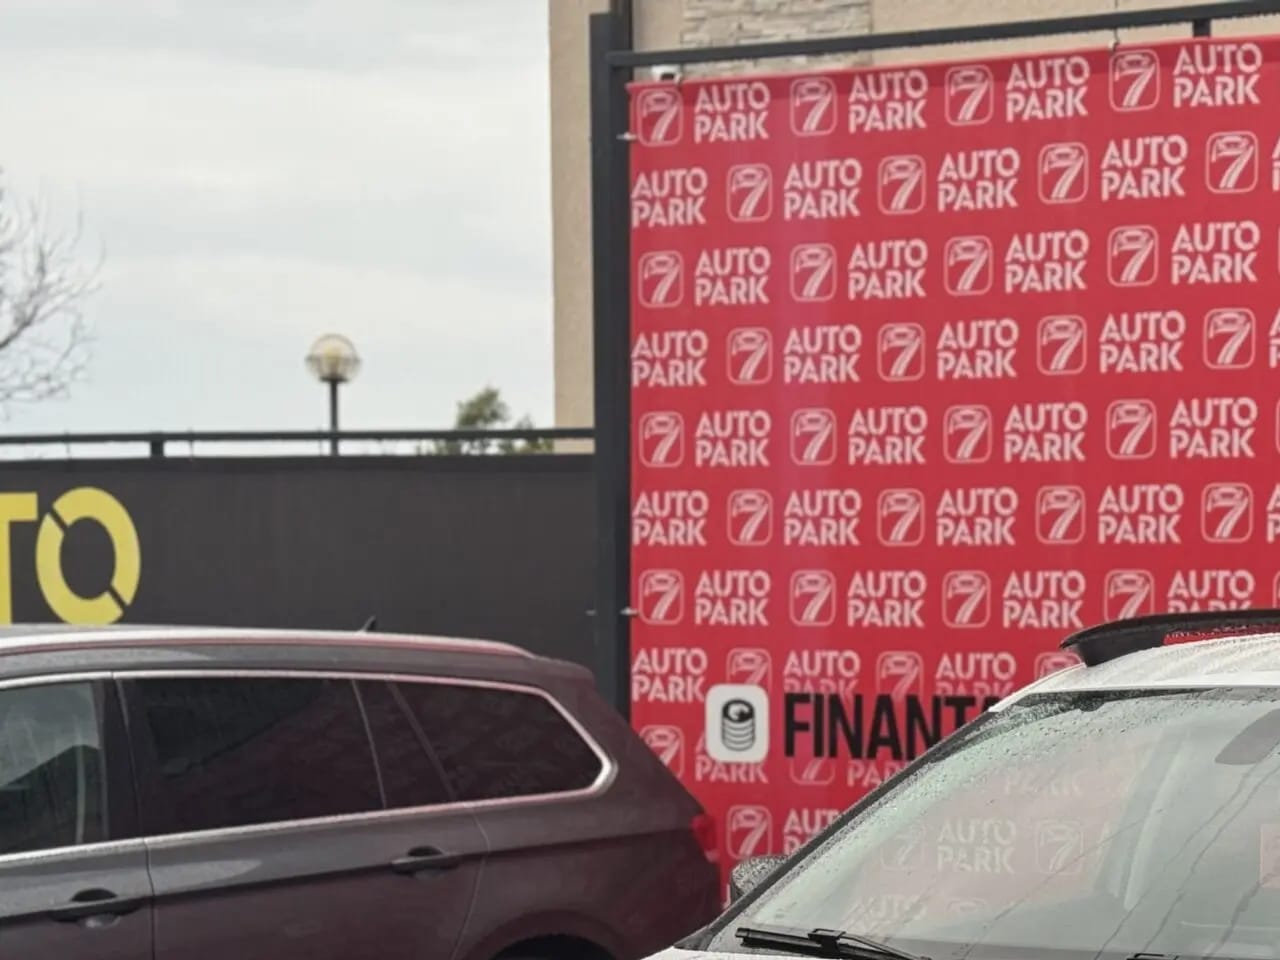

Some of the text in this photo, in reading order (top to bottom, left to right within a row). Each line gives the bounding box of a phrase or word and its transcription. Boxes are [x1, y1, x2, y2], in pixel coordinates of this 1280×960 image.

[1007, 58, 1089, 89] AUTO
[1173, 43, 1262, 77] AUTO
[695, 82, 770, 113] AUTO
[849, 71, 928, 102] AUTO
[1174, 74, 1260, 108] PARK
[849, 99, 926, 132] PARK
[1007, 88, 1088, 121] PARK
[694, 112, 769, 143] PARK
[938, 149, 1019, 179] AUTO
[1102, 135, 1188, 168] AUTO
[631, 169, 708, 200] AUTO
[784, 159, 862, 190] AUTO
[1102, 166, 1185, 201] PARK
[784, 188, 859, 219] PARK
[938, 178, 1018, 211] PARK
[632, 198, 706, 228] PARK
[1005, 230, 1089, 262] AUTO
[1172, 221, 1260, 254] AUTO
[696, 247, 771, 278] AUTO
[849, 239, 928, 271] AUTO
[1172, 251, 1258, 285] PARK
[696, 277, 769, 306] PARK
[849, 269, 926, 300] PARK
[1006, 259, 1086, 293] PARK
[784, 325, 861, 355] AUTO
[938, 319, 1018, 350] AUTO
[1100, 311, 1186, 342] AUTO
[631, 331, 708, 361] AUTO
[1100, 340, 1184, 374] PARK
[632, 358, 706, 388] PARK
[784, 352, 859, 384] PARK
[938, 347, 1017, 380] PARK
[696, 410, 771, 441] AUTO
[849, 408, 928, 439] AUTO
[1005, 402, 1088, 434] AUTO
[1170, 398, 1258, 430] AUTO
[696, 438, 769, 468] PARK
[849, 436, 926, 466] PARK
[1005, 432, 1085, 464] PARK
[1170, 427, 1254, 460] PARK
[632, 490, 708, 520] AUTO
[784, 489, 861, 519] AUTO
[938, 488, 1018, 518] AUTO
[1099, 484, 1184, 516] AUTO
[633, 518, 706, 546] PARK
[784, 517, 859, 547] PARK
[938, 516, 1016, 547] PARK
[1099, 513, 1181, 545] PARK
[696, 571, 771, 600] AUTO
[848, 571, 927, 601] AUTO
[1003, 571, 1086, 601] AUTO
[1168, 569, 1255, 598] AUTO
[696, 598, 769, 626] PARK
[848, 598, 926, 628] PARK
[1003, 599, 1084, 629] PARK
[631, 648, 708, 675] AUTO
[784, 650, 861, 677] AUTO
[936, 652, 1016, 679] AUTO
[631, 674, 705, 703] PARK
